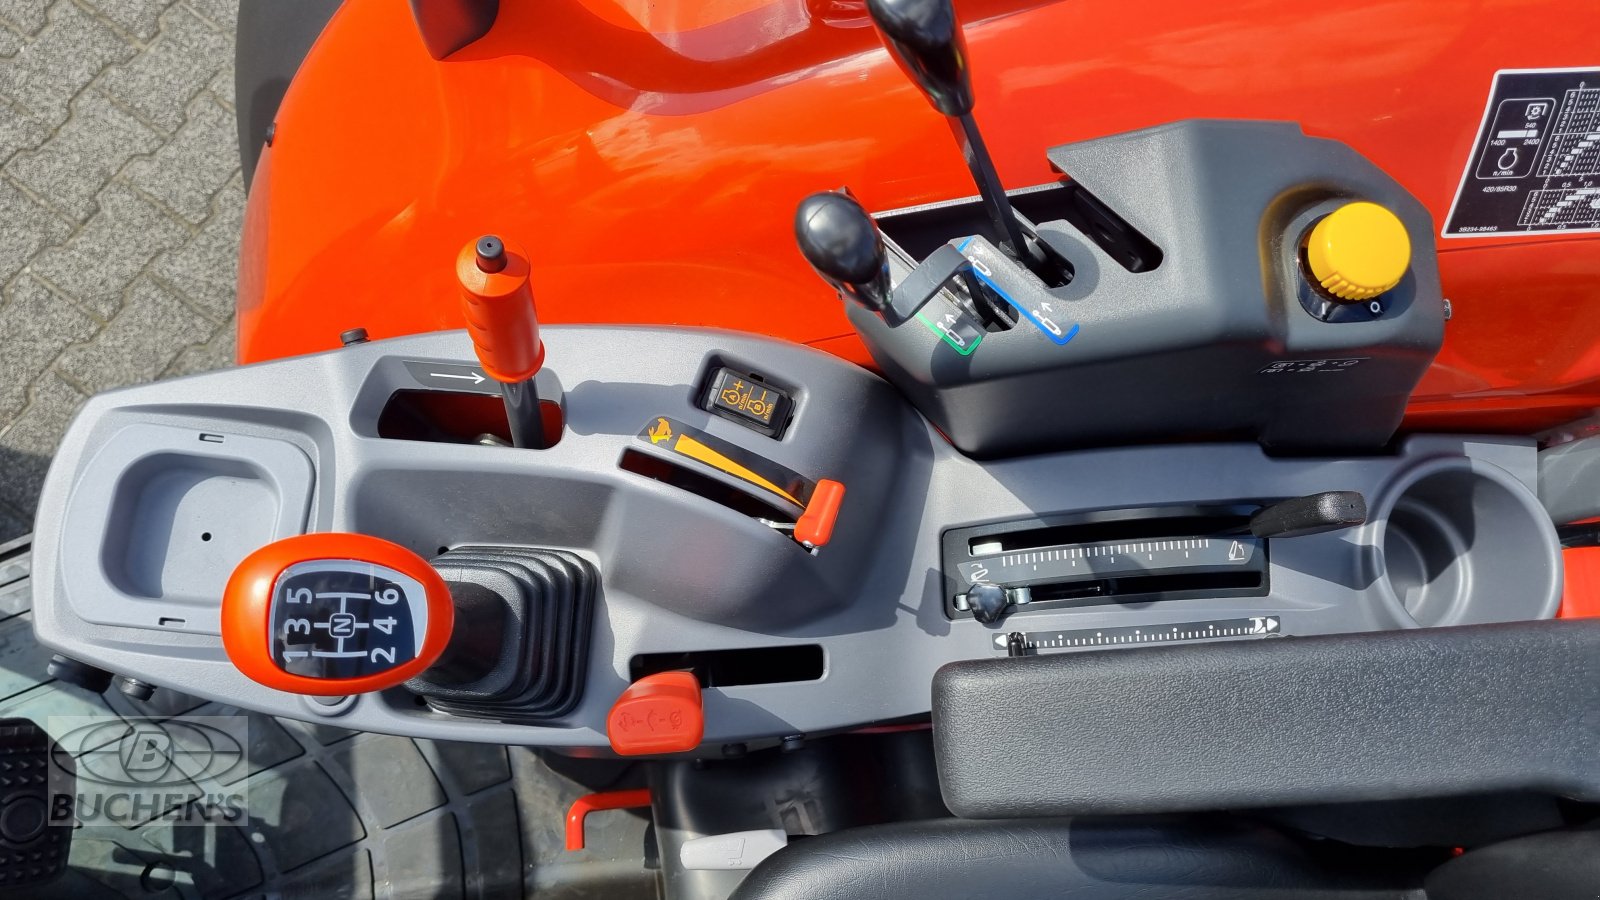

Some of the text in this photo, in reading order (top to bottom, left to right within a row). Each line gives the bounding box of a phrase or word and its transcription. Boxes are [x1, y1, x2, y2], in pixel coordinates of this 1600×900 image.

[286, 587, 399, 605] 5 6
[284, 616, 398, 635] 3 N 4
[282, 647, 396, 663] 1 2
